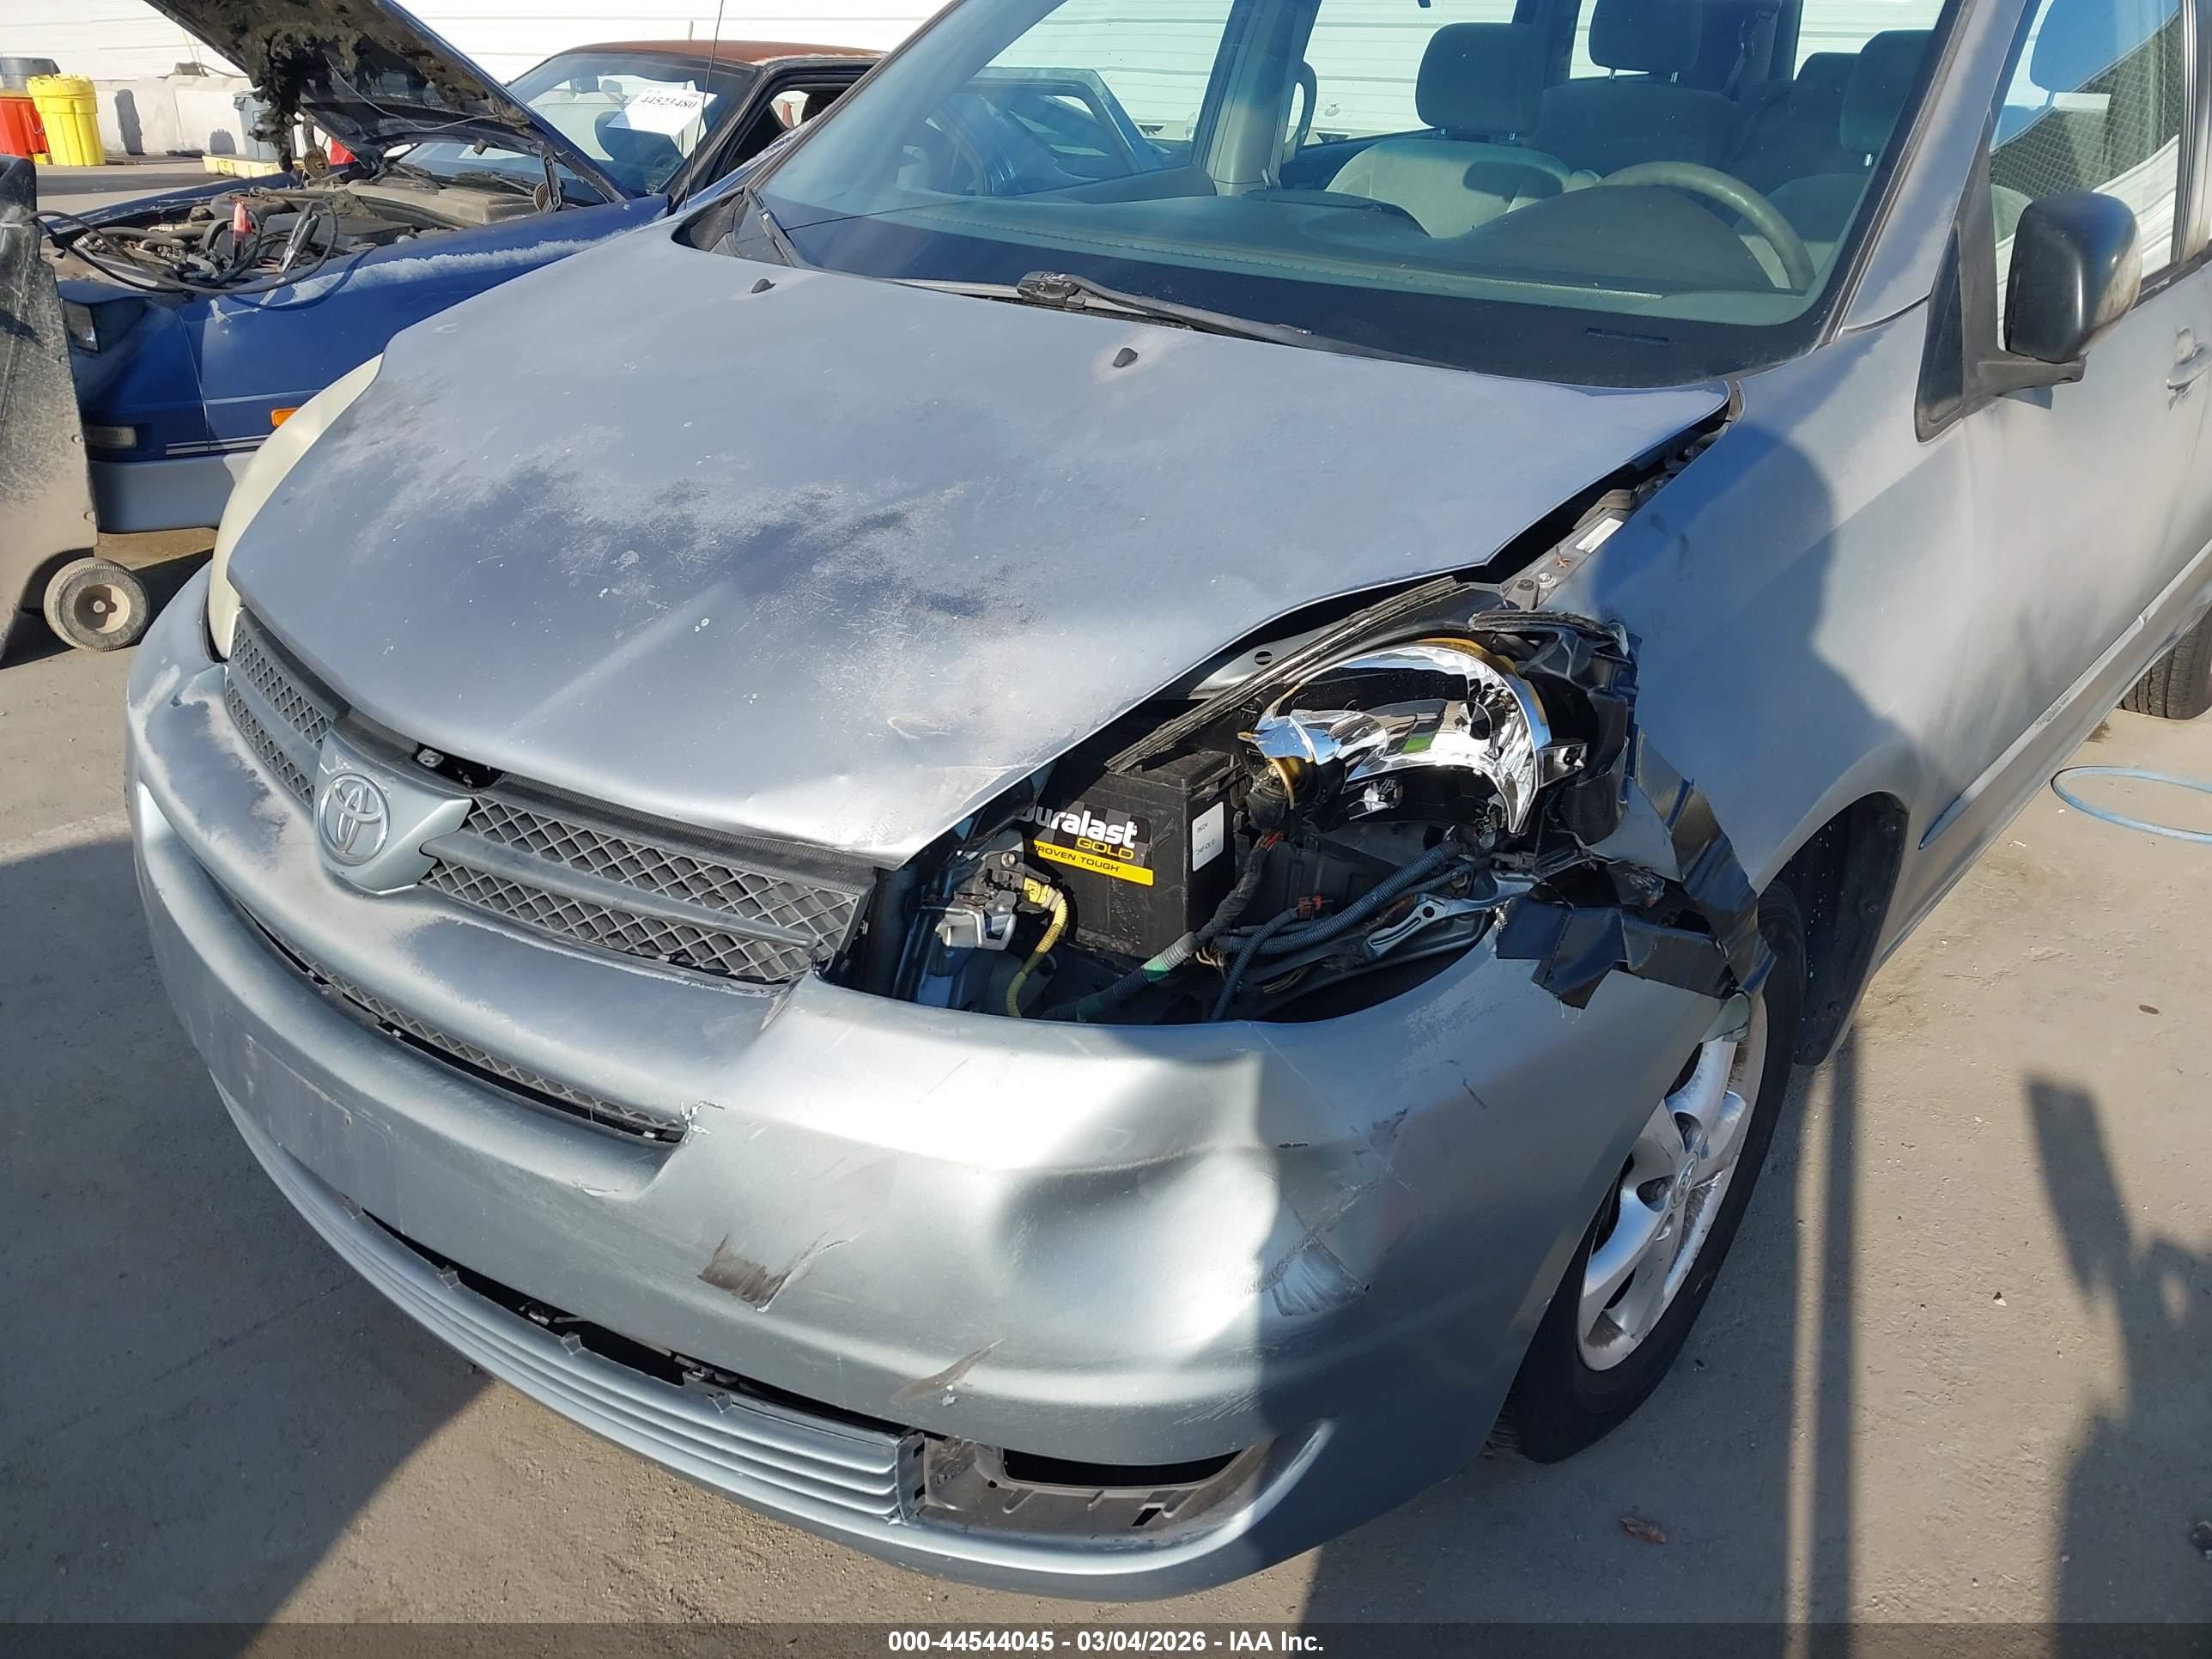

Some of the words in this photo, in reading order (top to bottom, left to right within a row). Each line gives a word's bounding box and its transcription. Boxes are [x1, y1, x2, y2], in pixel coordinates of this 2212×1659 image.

[640, 96, 697, 108] 44523480
[1076, 837, 1134, 860] GOLD
[1080, 856, 1119, 872] TOUGH
